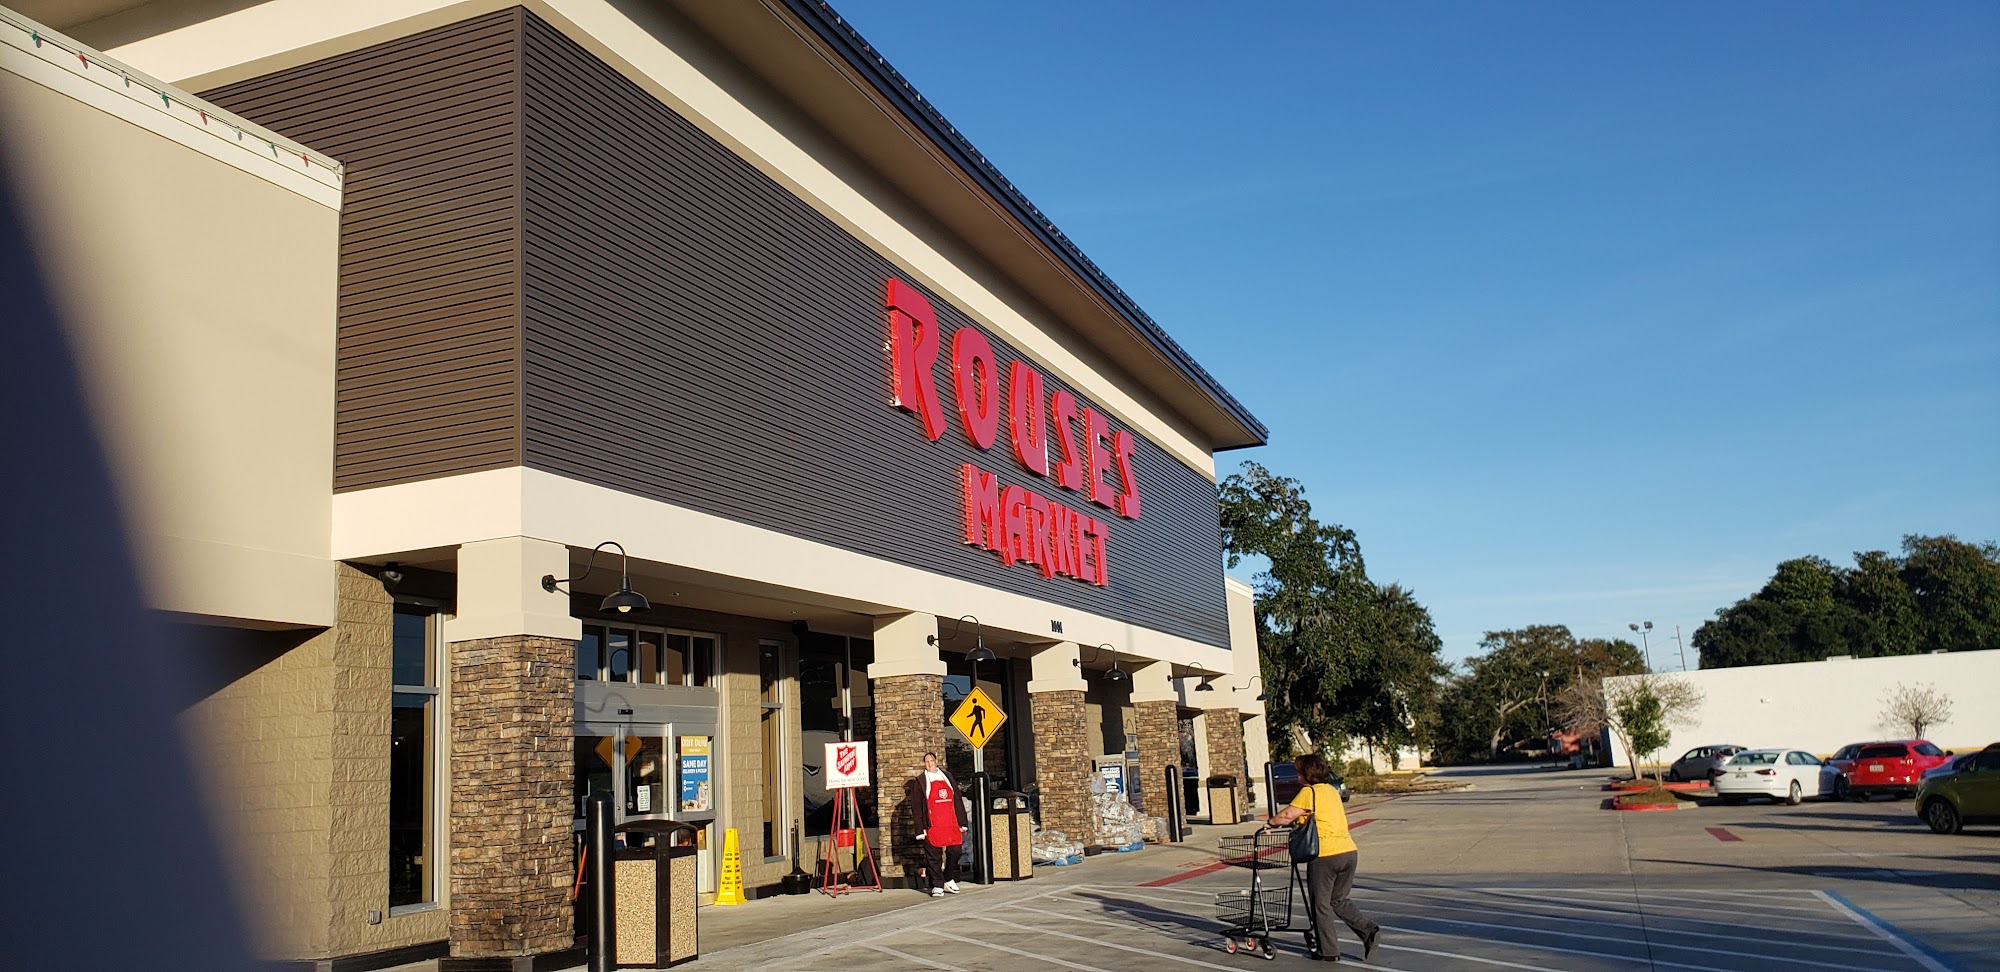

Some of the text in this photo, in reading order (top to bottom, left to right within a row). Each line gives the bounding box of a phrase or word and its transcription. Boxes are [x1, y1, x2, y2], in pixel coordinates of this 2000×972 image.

[887, 277, 1141, 520] ROUSES
[962, 463, 1109, 587] MARKET
[682, 759, 707, 768] SAME DAY
